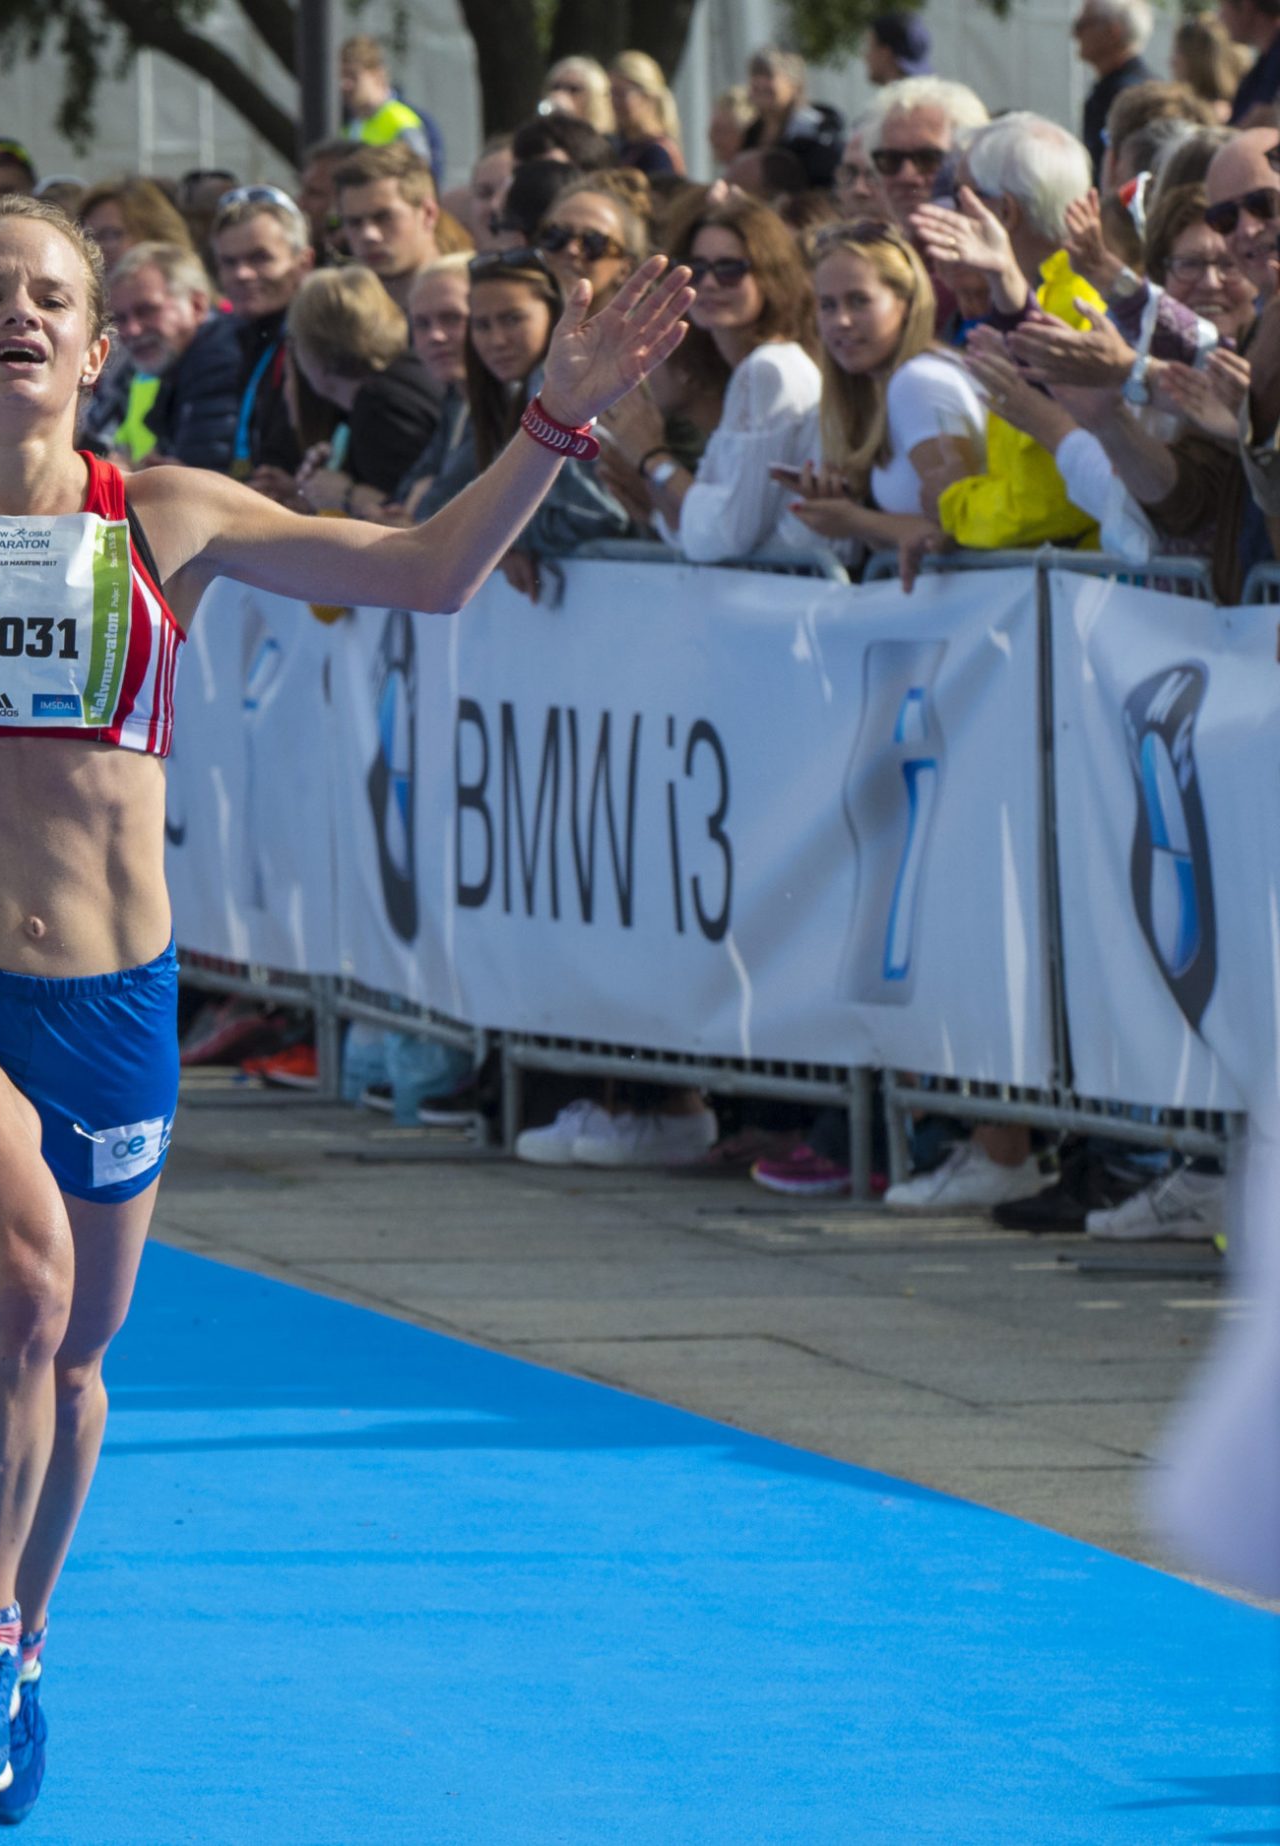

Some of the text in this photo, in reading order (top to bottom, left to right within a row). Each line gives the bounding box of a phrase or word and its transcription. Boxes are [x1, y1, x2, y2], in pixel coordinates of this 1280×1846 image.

[40, 701, 76, 710] IMSDAL
[456, 697, 734, 944] BMW i3
